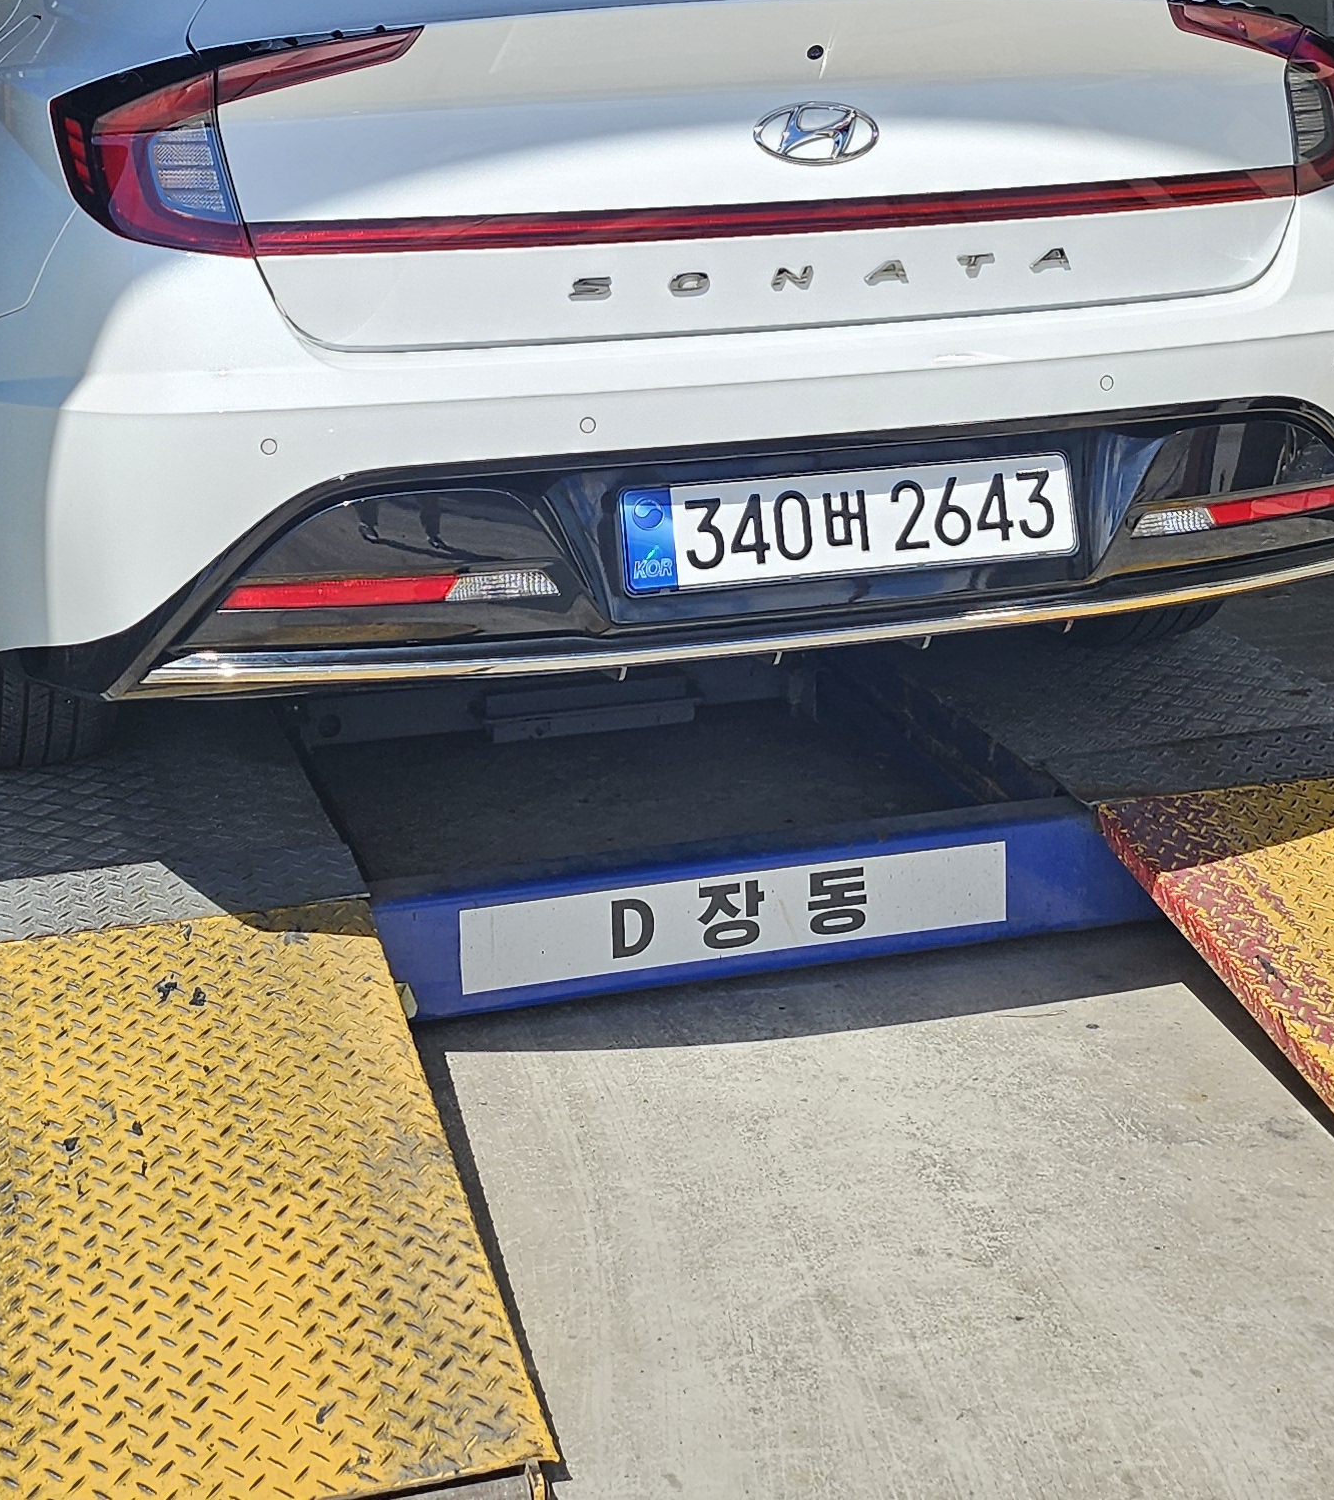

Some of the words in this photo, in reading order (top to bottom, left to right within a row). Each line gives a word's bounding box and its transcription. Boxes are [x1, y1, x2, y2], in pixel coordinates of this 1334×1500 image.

[567, 246, 1072, 302] SONATA
[890, 468, 1055, 552] 2643
[633, 557, 673, 580] KOR
